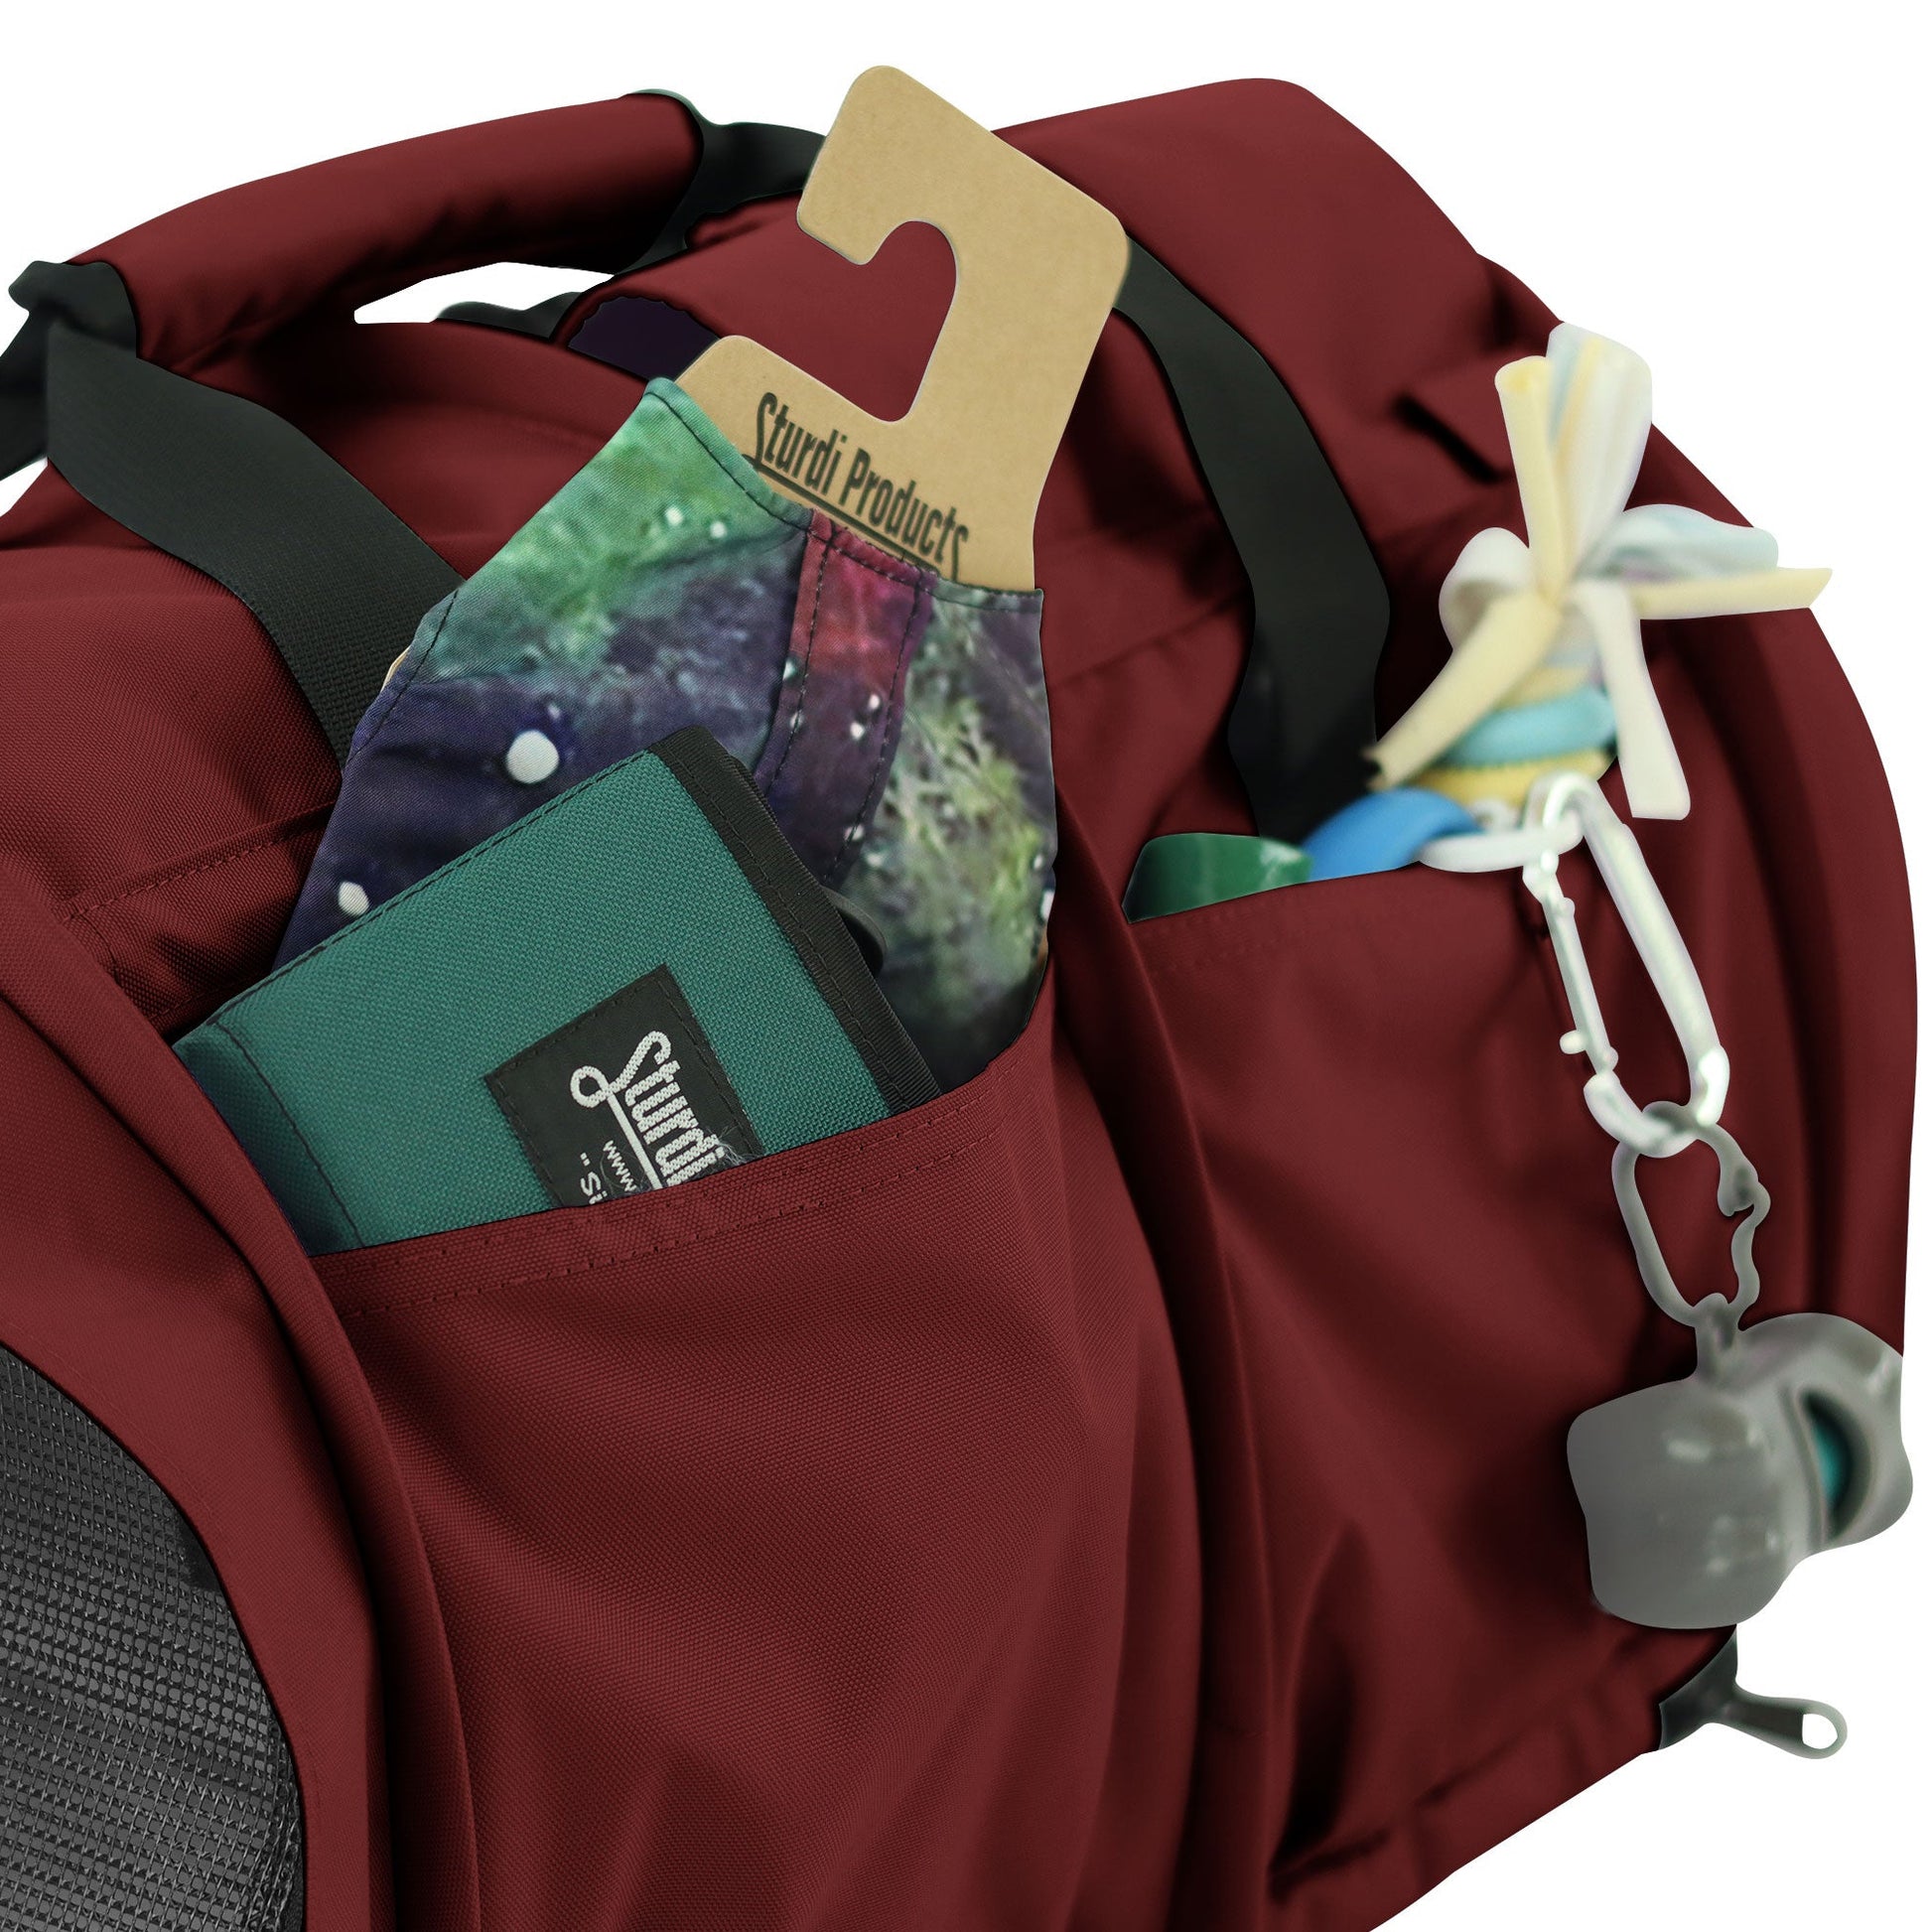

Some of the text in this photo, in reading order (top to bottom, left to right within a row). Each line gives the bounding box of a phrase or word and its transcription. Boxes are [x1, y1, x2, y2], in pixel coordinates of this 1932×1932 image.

[751, 391, 969, 582] Sturdi Products
[570, 1031, 725, 1187] Sturdi
